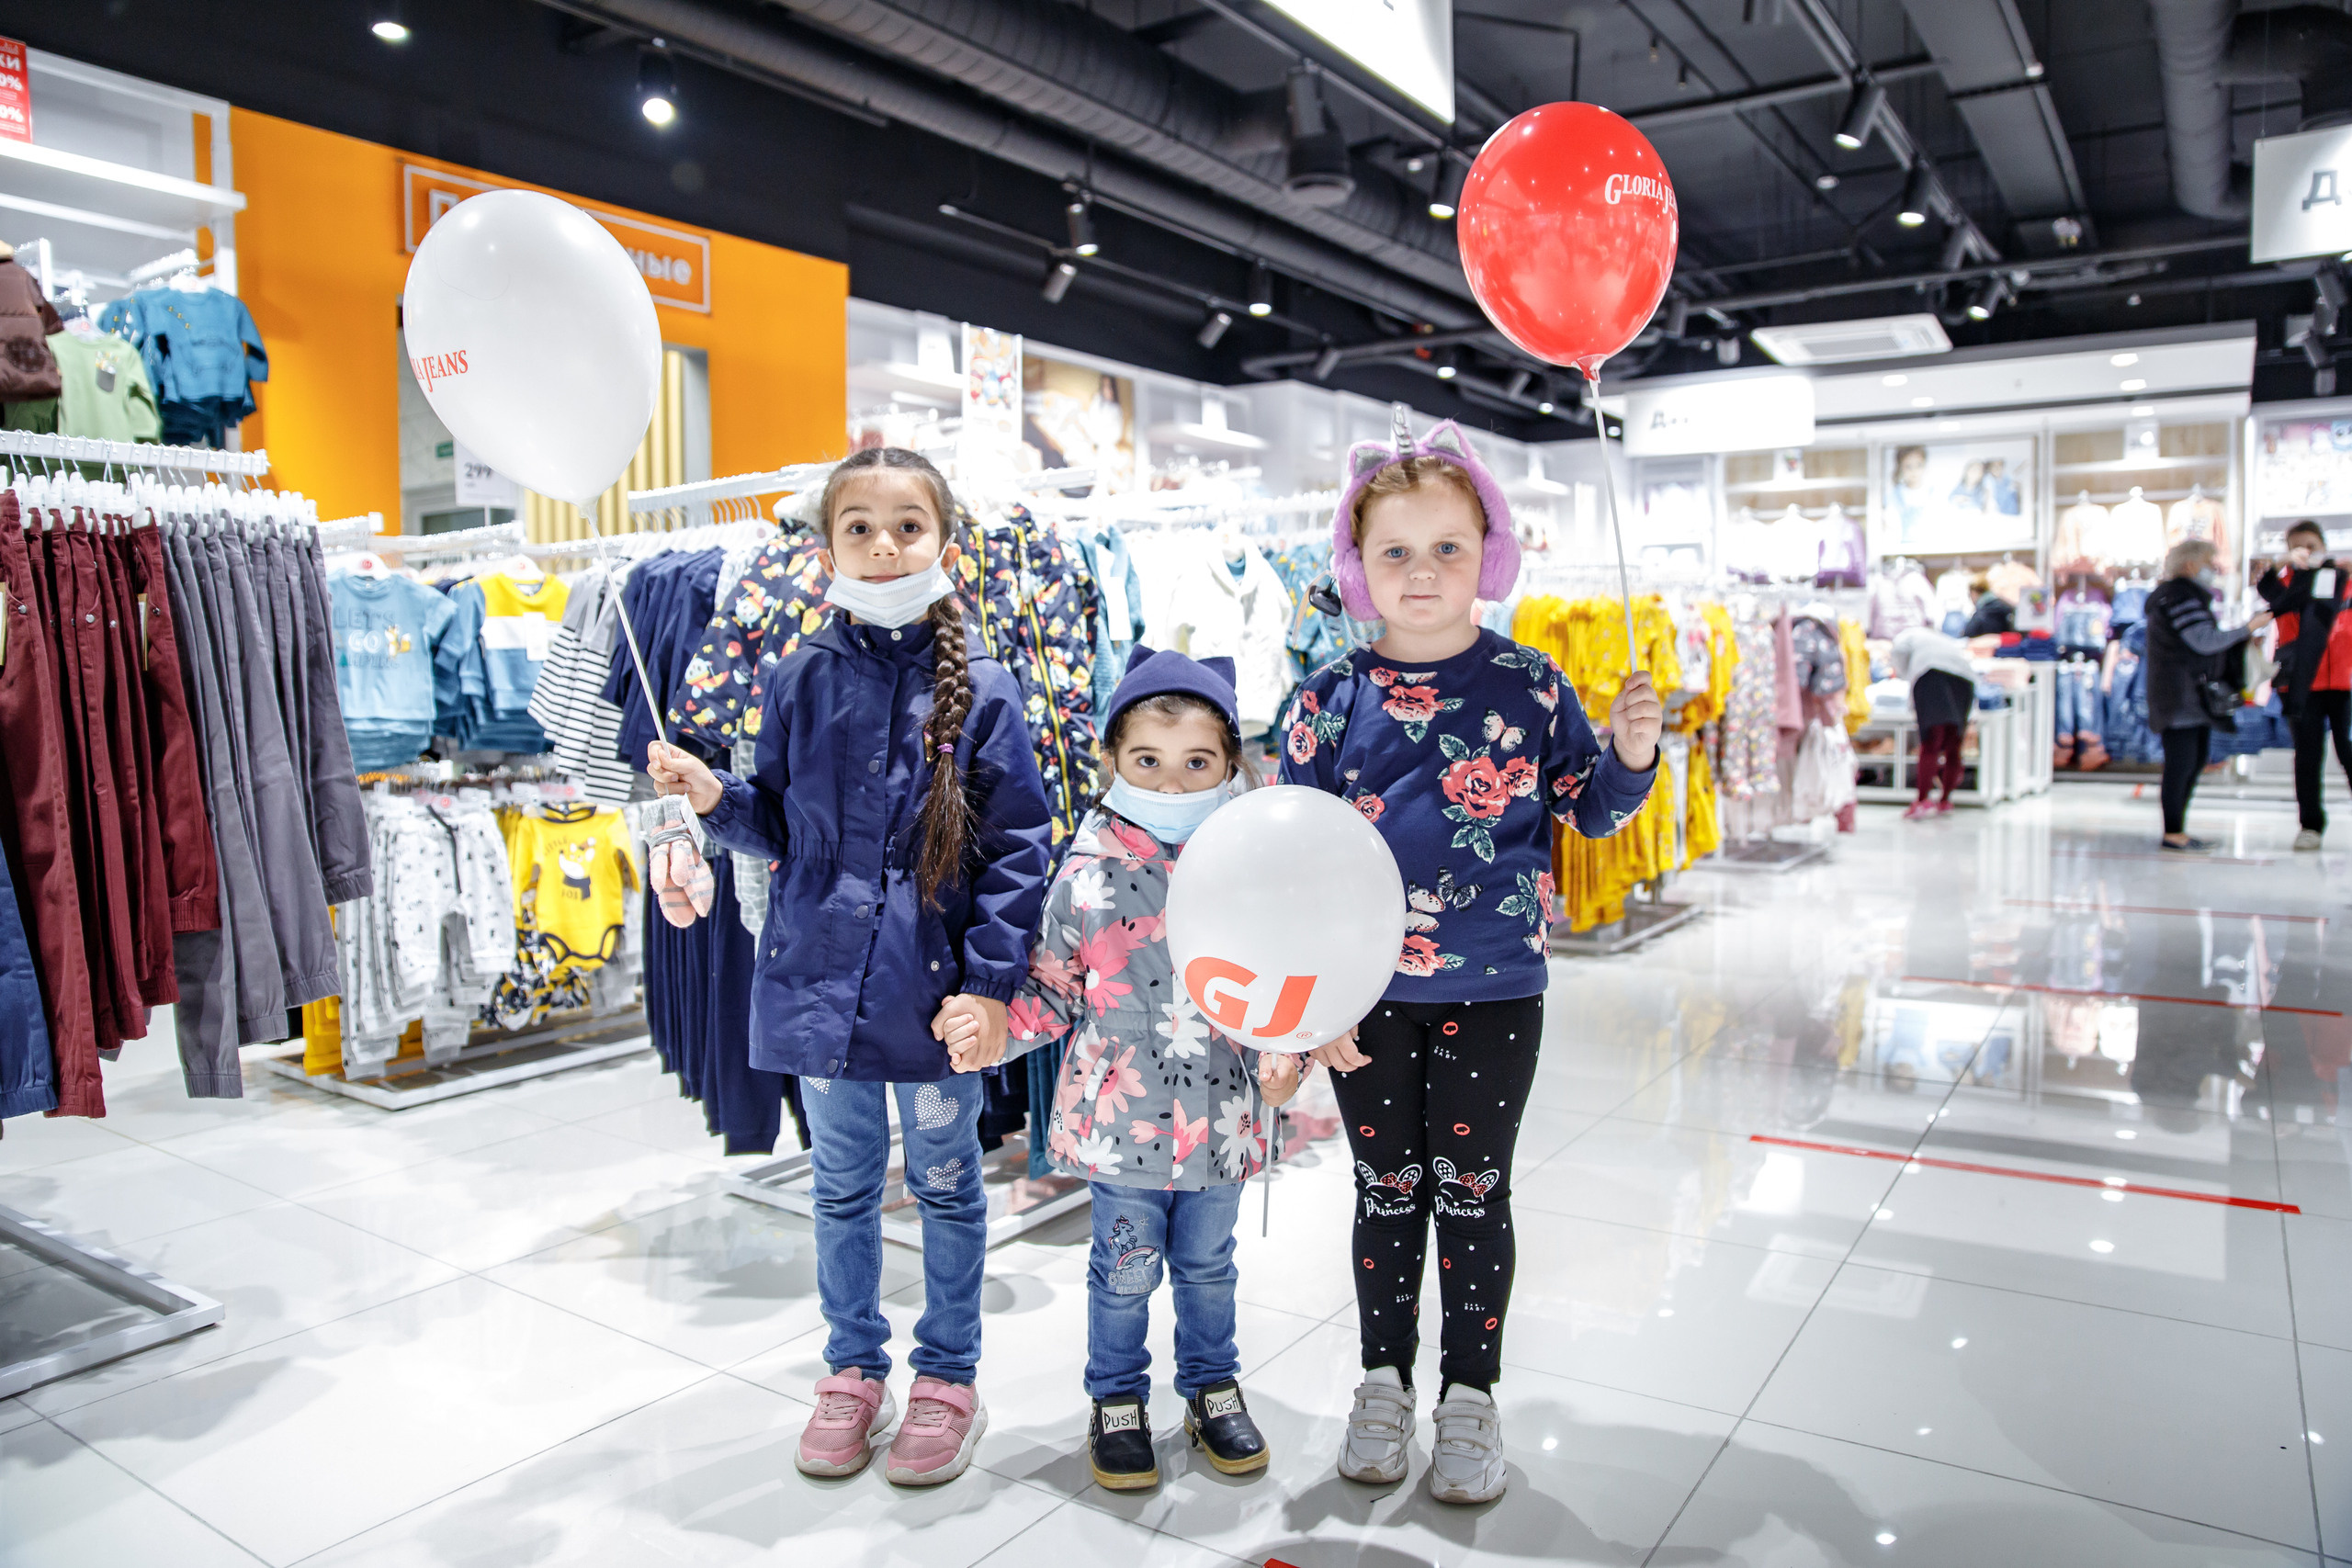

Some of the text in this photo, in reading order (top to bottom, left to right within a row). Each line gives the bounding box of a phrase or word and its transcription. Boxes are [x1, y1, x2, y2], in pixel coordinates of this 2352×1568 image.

[1604, 174, 1664, 205] GLORIA
[422, 350, 469, 392] JEANS
[348, 629, 383, 654] GO
[1184, 956, 1318, 1038] GJ
[1363, 1196, 1416, 1218] Princess
[1434, 1195, 1486, 1218] Princess
[1206, 1393, 1238, 1415] PUSH
[1103, 1408, 1138, 1429] PUSH
